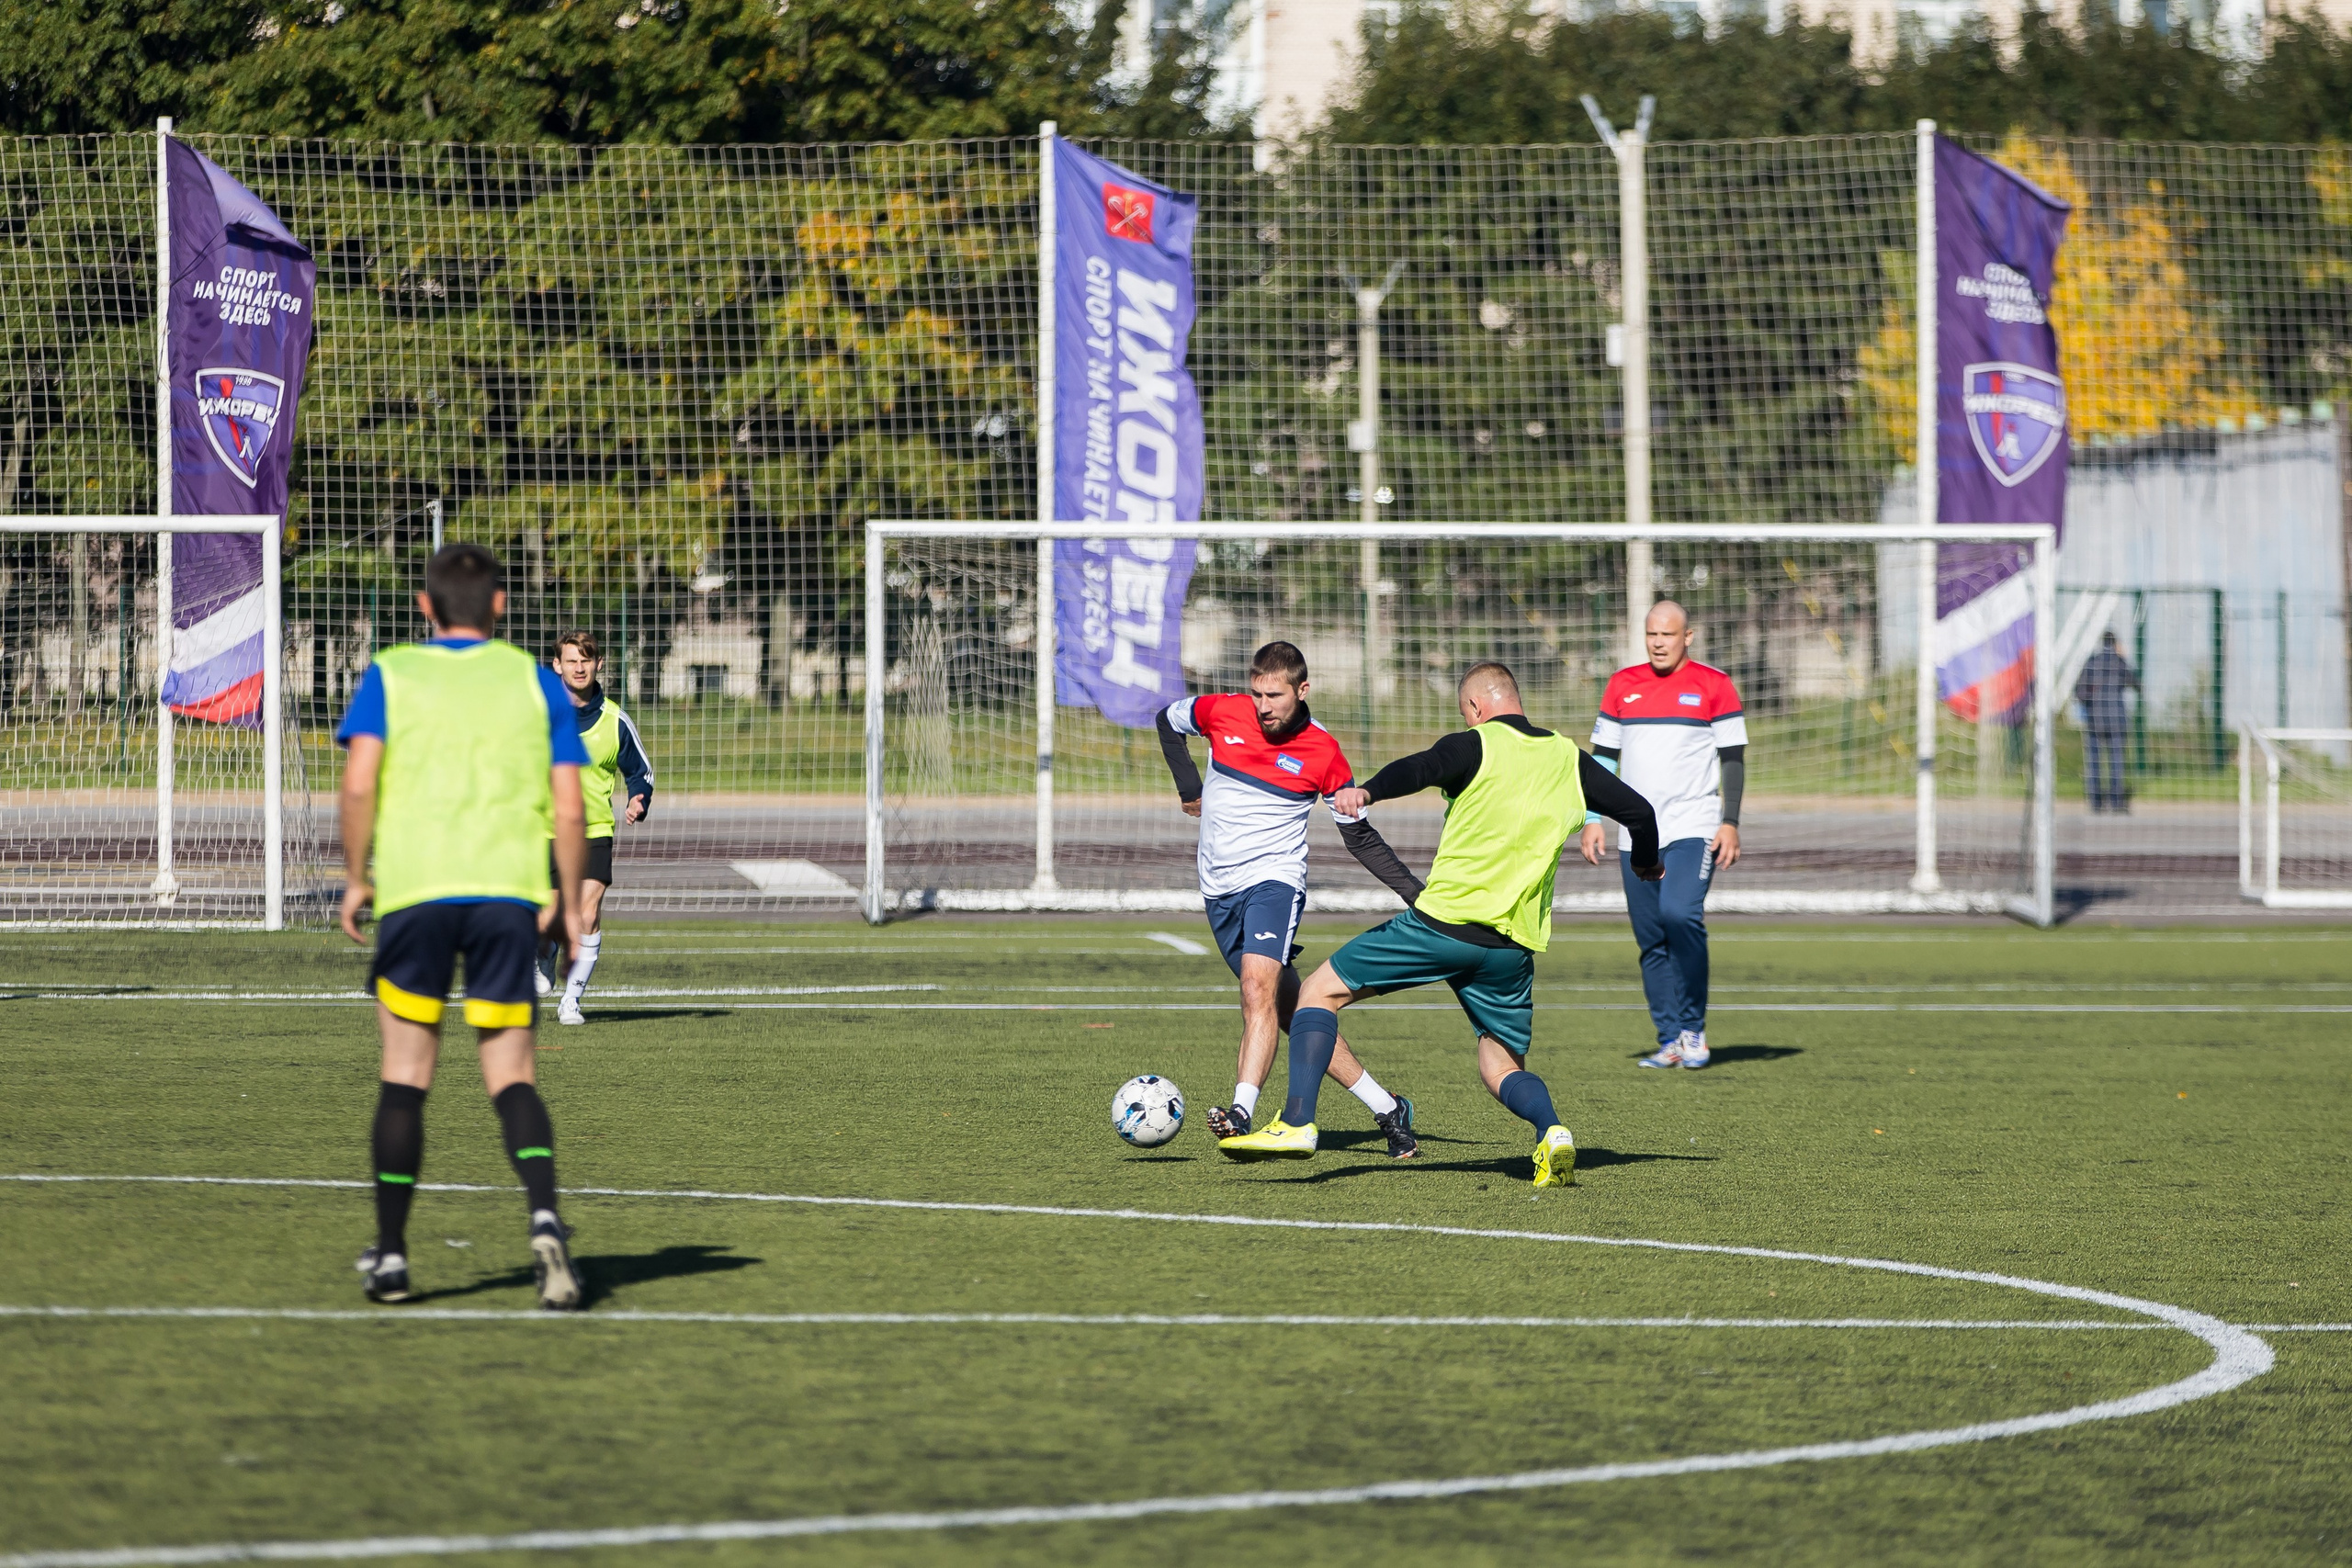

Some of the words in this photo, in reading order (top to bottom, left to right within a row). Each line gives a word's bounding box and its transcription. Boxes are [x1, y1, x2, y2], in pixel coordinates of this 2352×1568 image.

[220, 265, 277, 290] СПОРТ
[193, 280, 302, 315] НАЧИНАЕТСЯ
[218, 302, 272, 327] ЗДЕСЬ
[1085, 254, 1113, 358] СПОРТ
[1102, 267, 1178, 694] ИЖОРЕЦ
